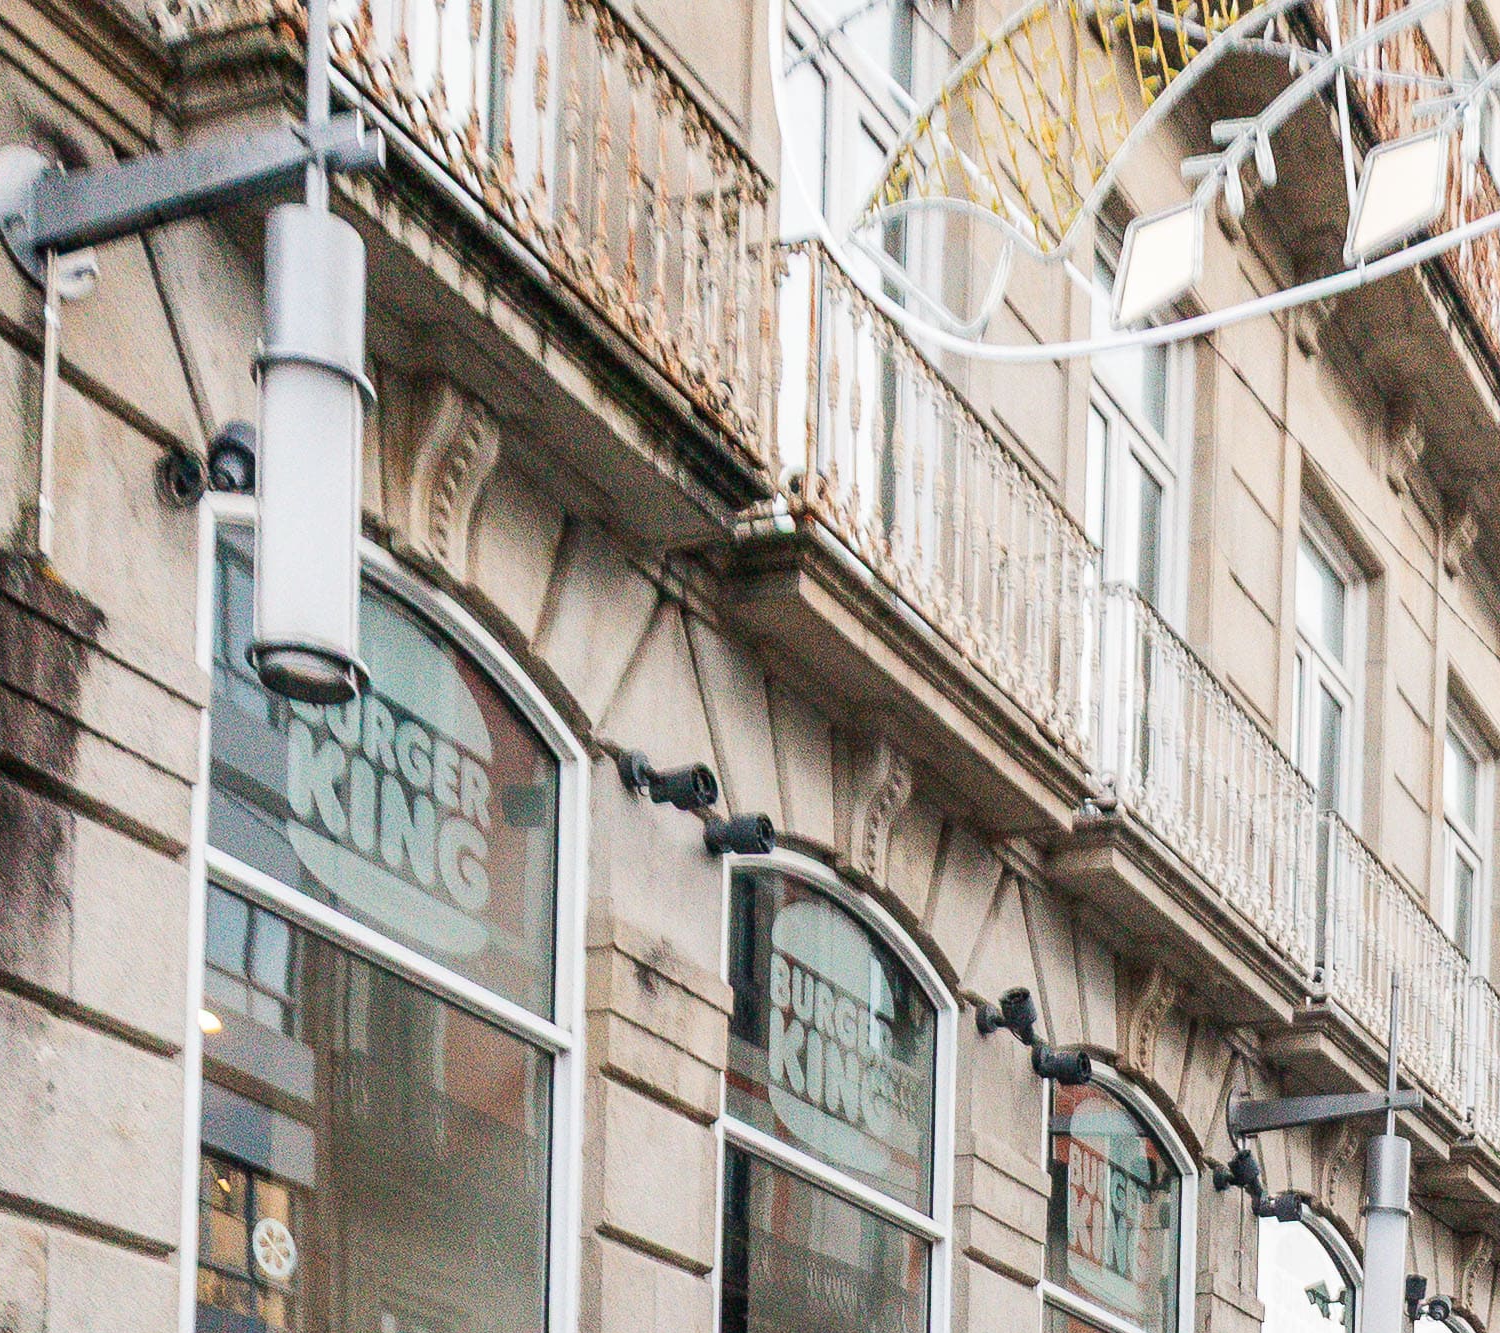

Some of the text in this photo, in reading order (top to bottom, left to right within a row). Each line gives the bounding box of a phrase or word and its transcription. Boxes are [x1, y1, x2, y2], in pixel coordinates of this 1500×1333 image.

[287, 717, 490, 909] KING
[290, 695, 491, 829] URGER
[768, 1005, 896, 1137] KING
